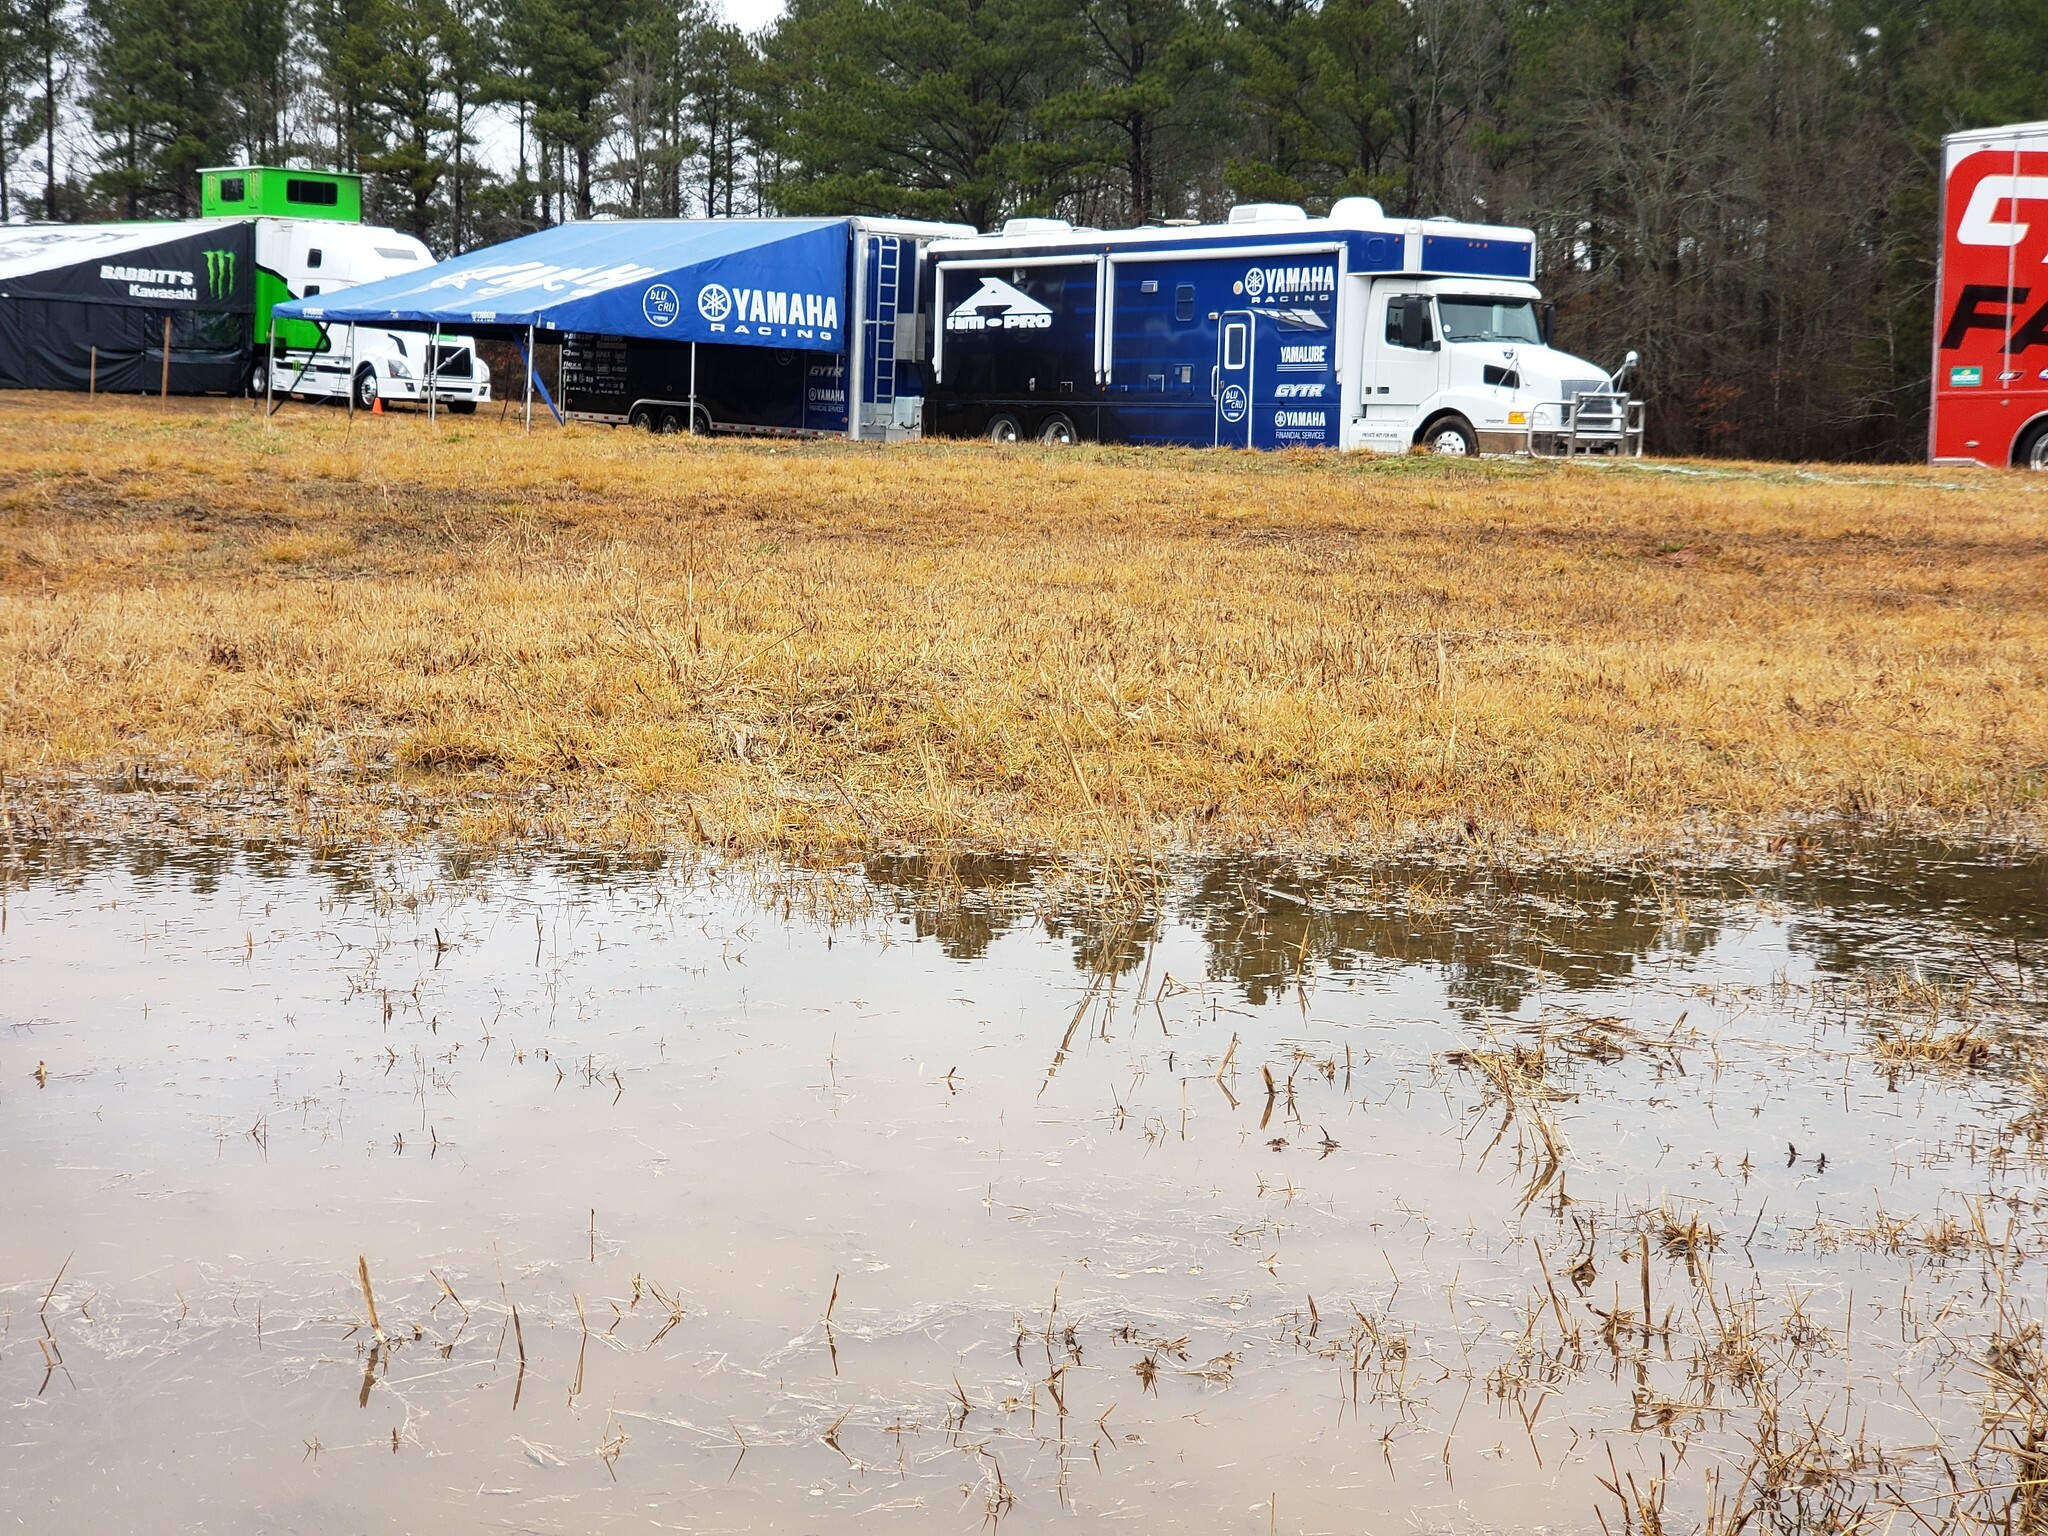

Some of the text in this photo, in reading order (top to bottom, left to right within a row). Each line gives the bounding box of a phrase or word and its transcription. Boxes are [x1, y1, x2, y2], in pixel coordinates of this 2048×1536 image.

[99, 265, 195, 286] BABBITT'S
[1264, 265, 1335, 294] YAMAHA
[128, 284, 198, 301] Kawasaki
[1250, 294, 1330, 304] RACING
[732, 287, 838, 330] YAMAHA
[710, 323, 833, 341] RACING
[1280, 345, 1326, 363] YAMALUBE
[809, 365, 845, 378] GYTR
[816, 388, 845, 403] YAMAHA
[1274, 383, 1326, 398] GYTR
[1286, 411, 1326, 427] YAMAHA
[1276, 431, 1325, 440] FINANCIAL SERVICES
